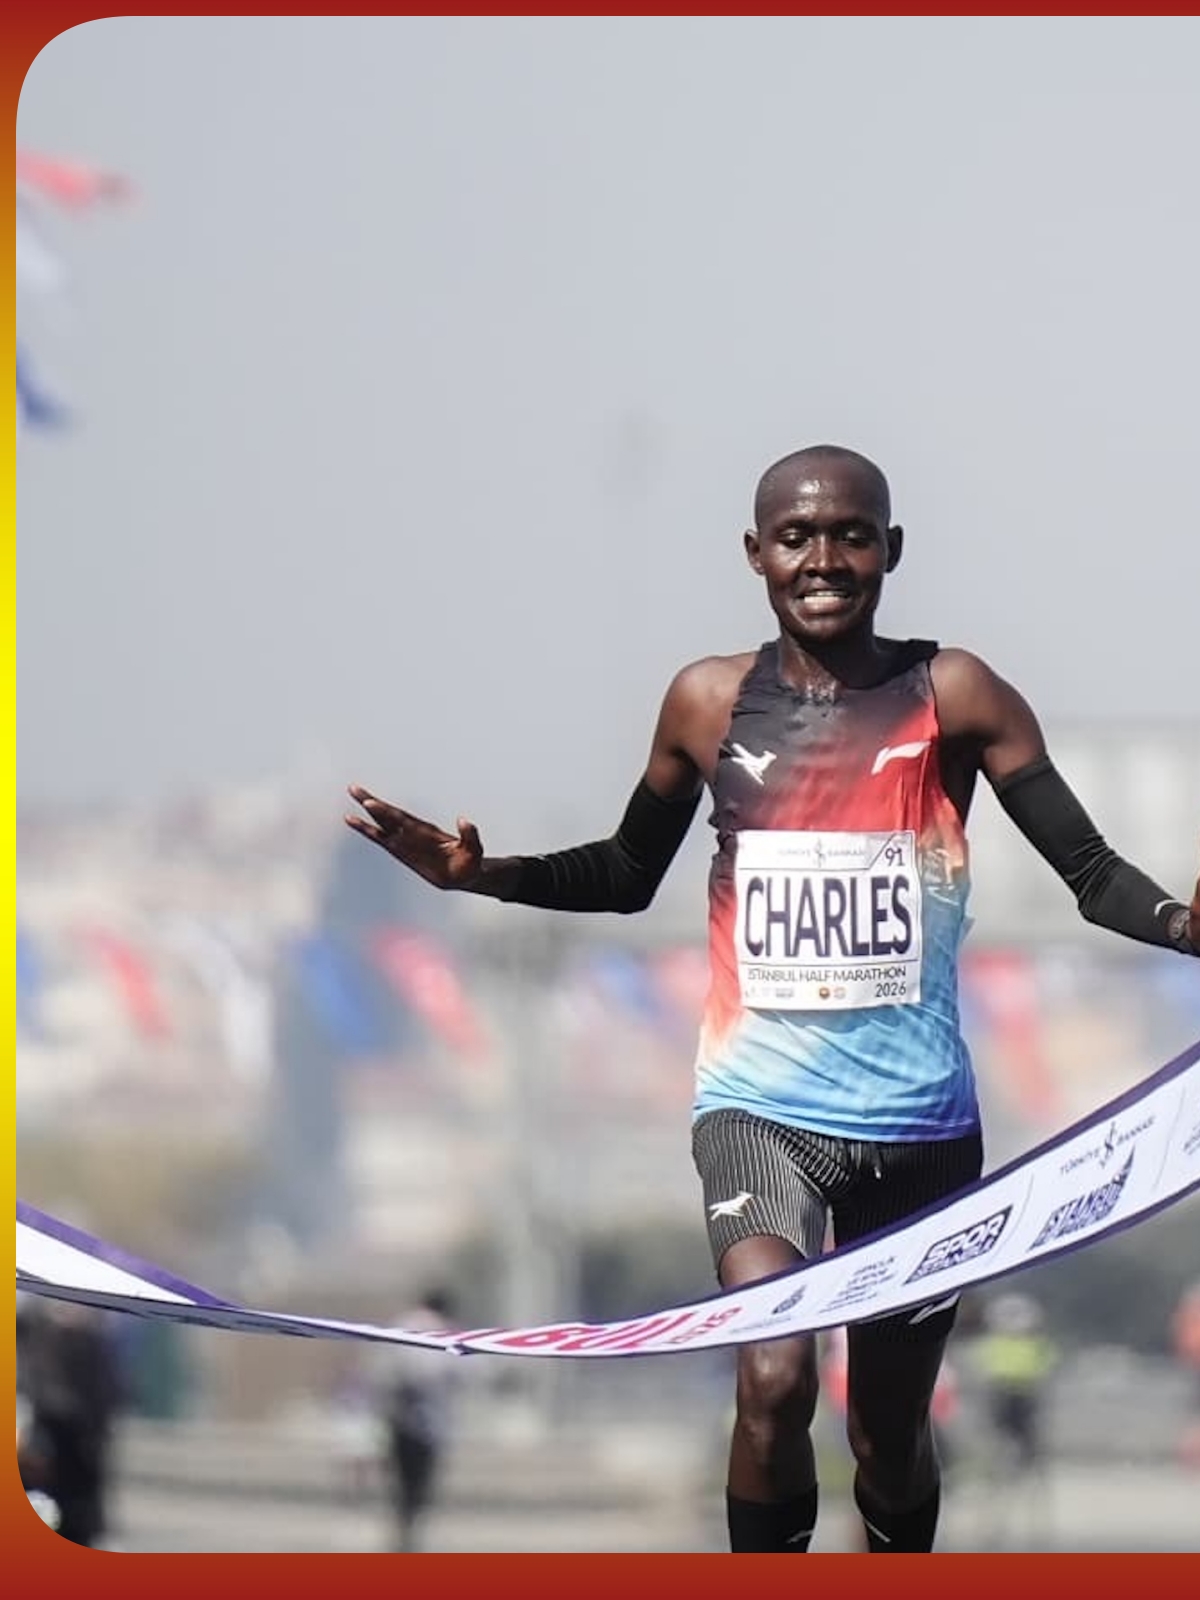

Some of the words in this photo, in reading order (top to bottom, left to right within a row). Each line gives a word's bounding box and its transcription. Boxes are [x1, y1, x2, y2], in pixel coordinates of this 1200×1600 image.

[884, 847, 906, 867] 91
[745, 875, 913, 958] CHARLES
[799, 968, 833, 983] HALF
[833, 965, 907, 983] MARATHON
[875, 982, 907, 999] 2026
[926, 1212, 1006, 1260] SPOR
